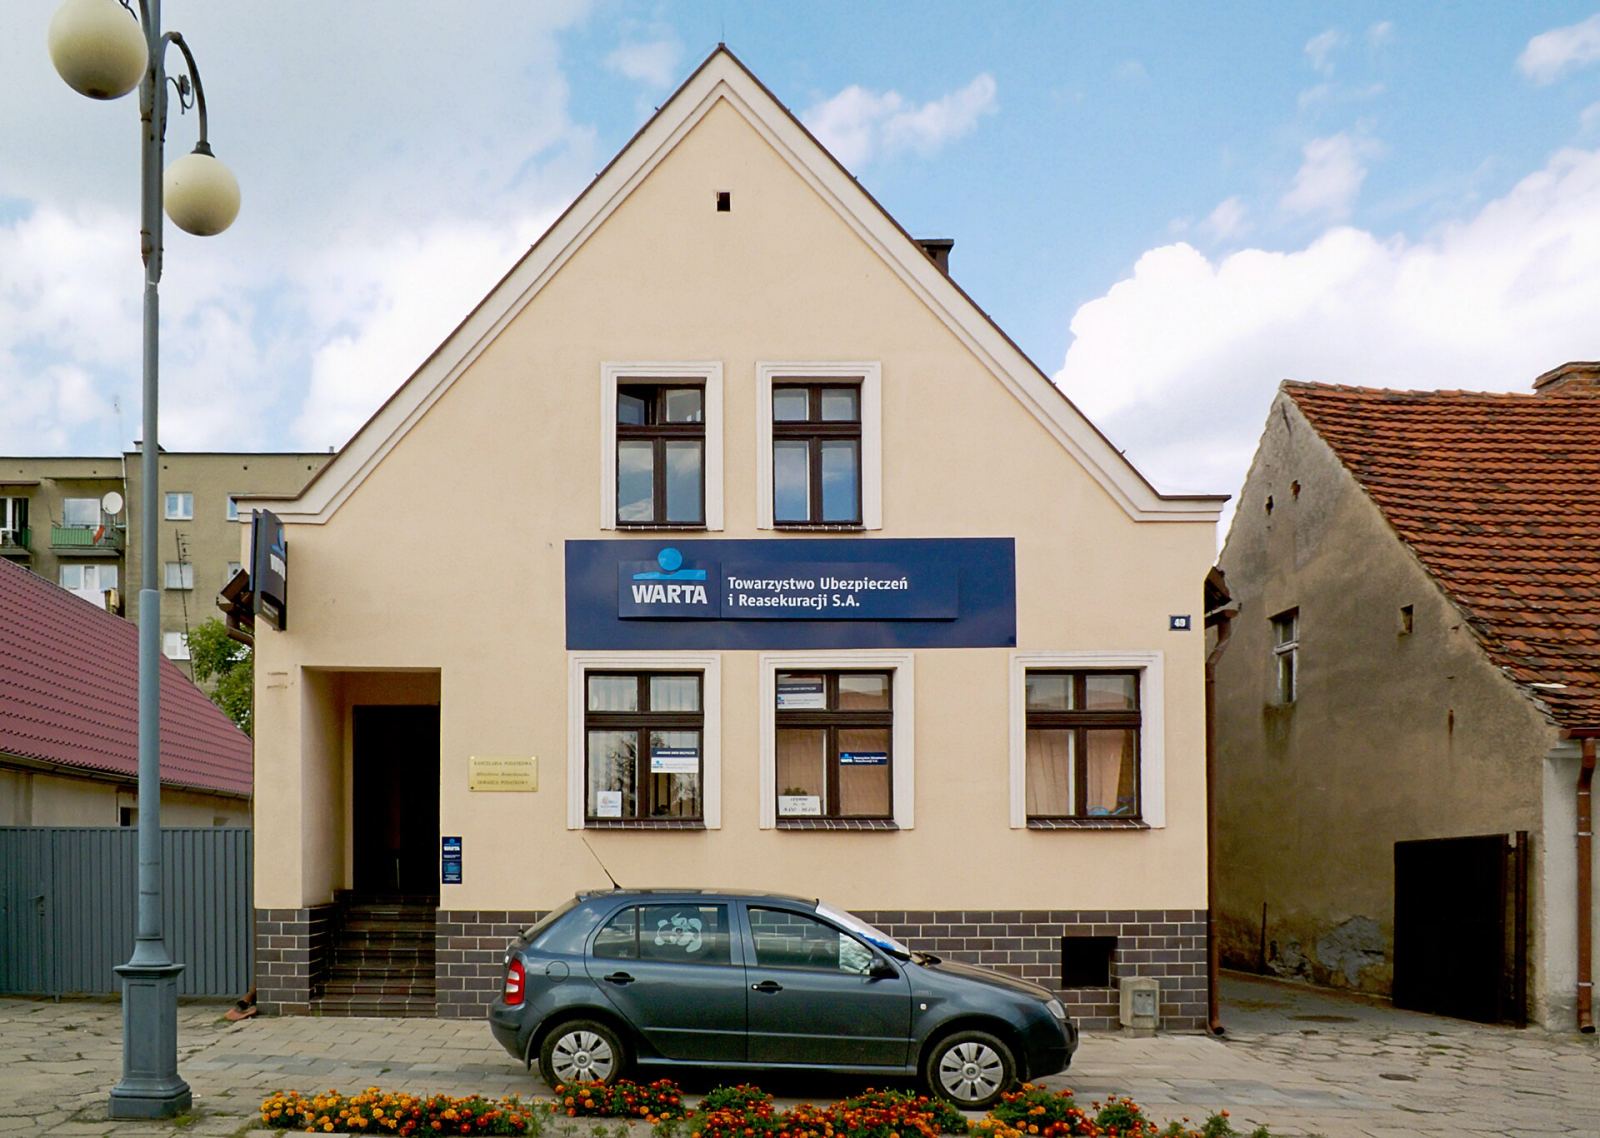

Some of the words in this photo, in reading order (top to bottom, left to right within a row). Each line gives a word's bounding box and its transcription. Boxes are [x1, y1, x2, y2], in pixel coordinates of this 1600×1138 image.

[727, 577, 815, 593] Towarzystwo
[820, 576, 908, 593] Ubezpieczeń
[631, 585, 708, 605] WARTA
[727, 594, 733, 607] i
[738, 593, 828, 611] Reasekuracji
[832, 594, 860, 607] S.A.
